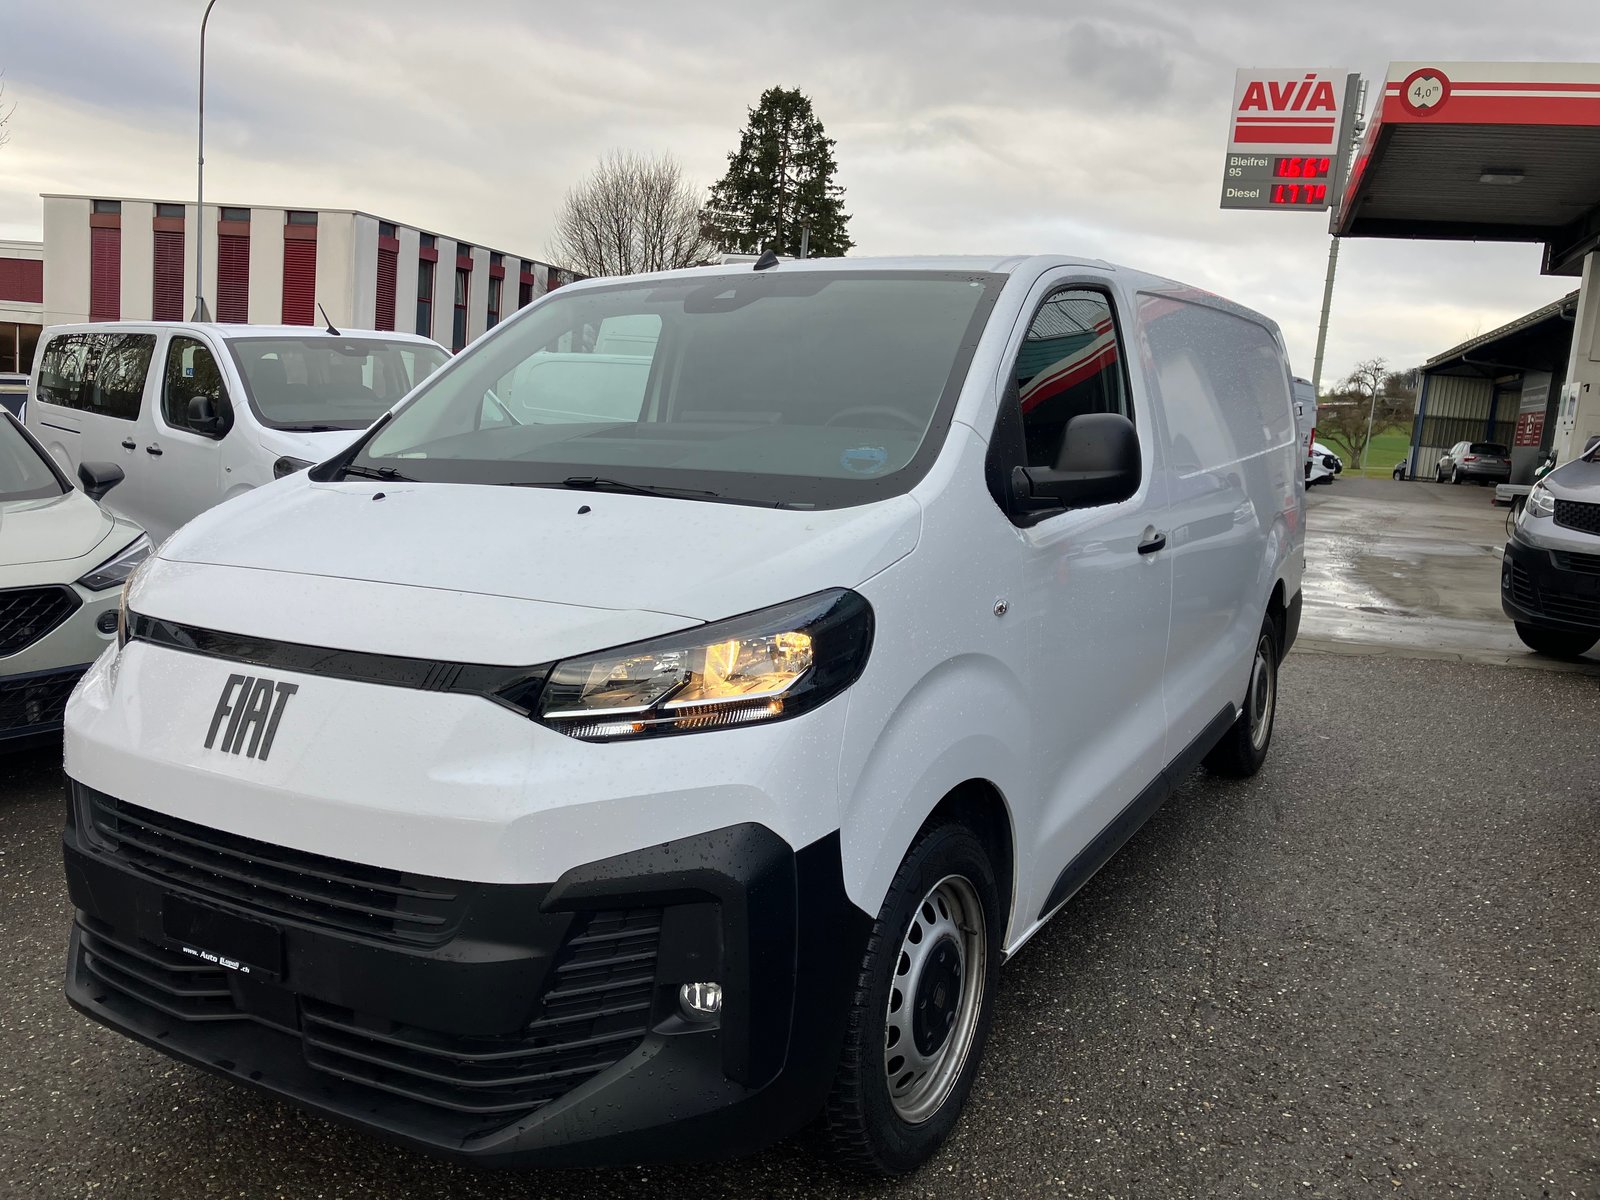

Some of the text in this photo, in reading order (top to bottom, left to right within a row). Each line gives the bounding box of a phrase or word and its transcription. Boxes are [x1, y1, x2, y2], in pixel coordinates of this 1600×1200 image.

[1230, 157, 1268, 167] Bleifrei
[1228, 168, 1242, 177] 95
[1226, 188, 1260, 198] Diesel
[203, 673, 300, 762] FIAT
[199, 951, 218, 963] Auto
